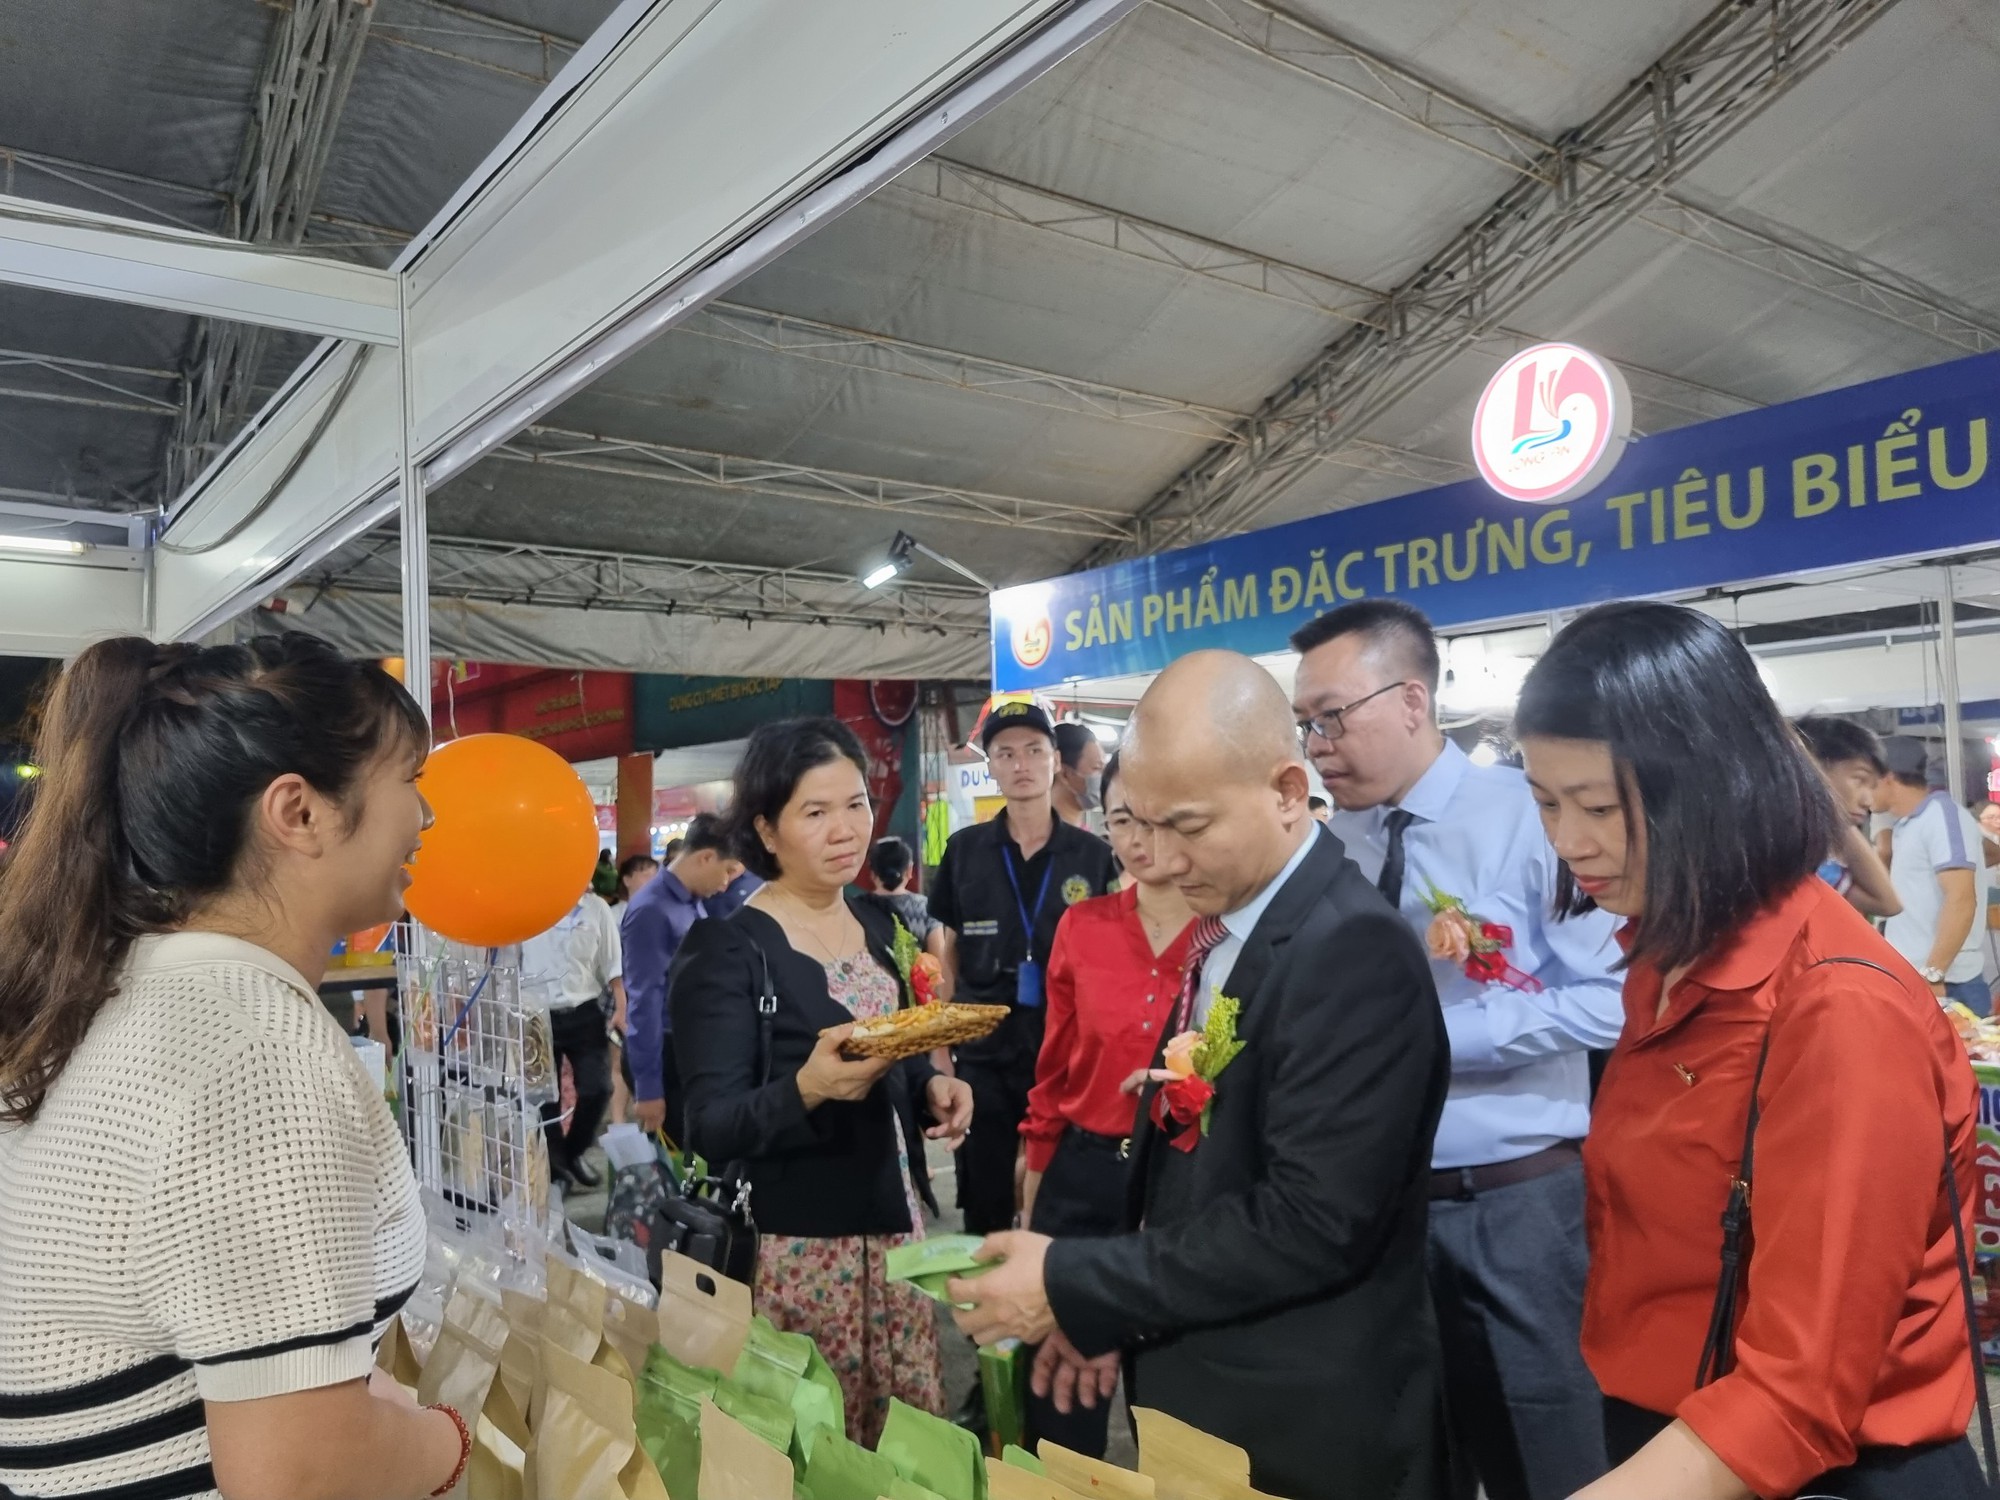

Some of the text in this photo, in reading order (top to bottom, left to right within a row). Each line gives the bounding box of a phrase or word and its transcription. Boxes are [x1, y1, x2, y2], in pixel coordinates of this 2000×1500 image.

[1065, 407, 1989, 651] SẢN PHẨM ĐẶC TRƯNG, TIÊU BIỂU
